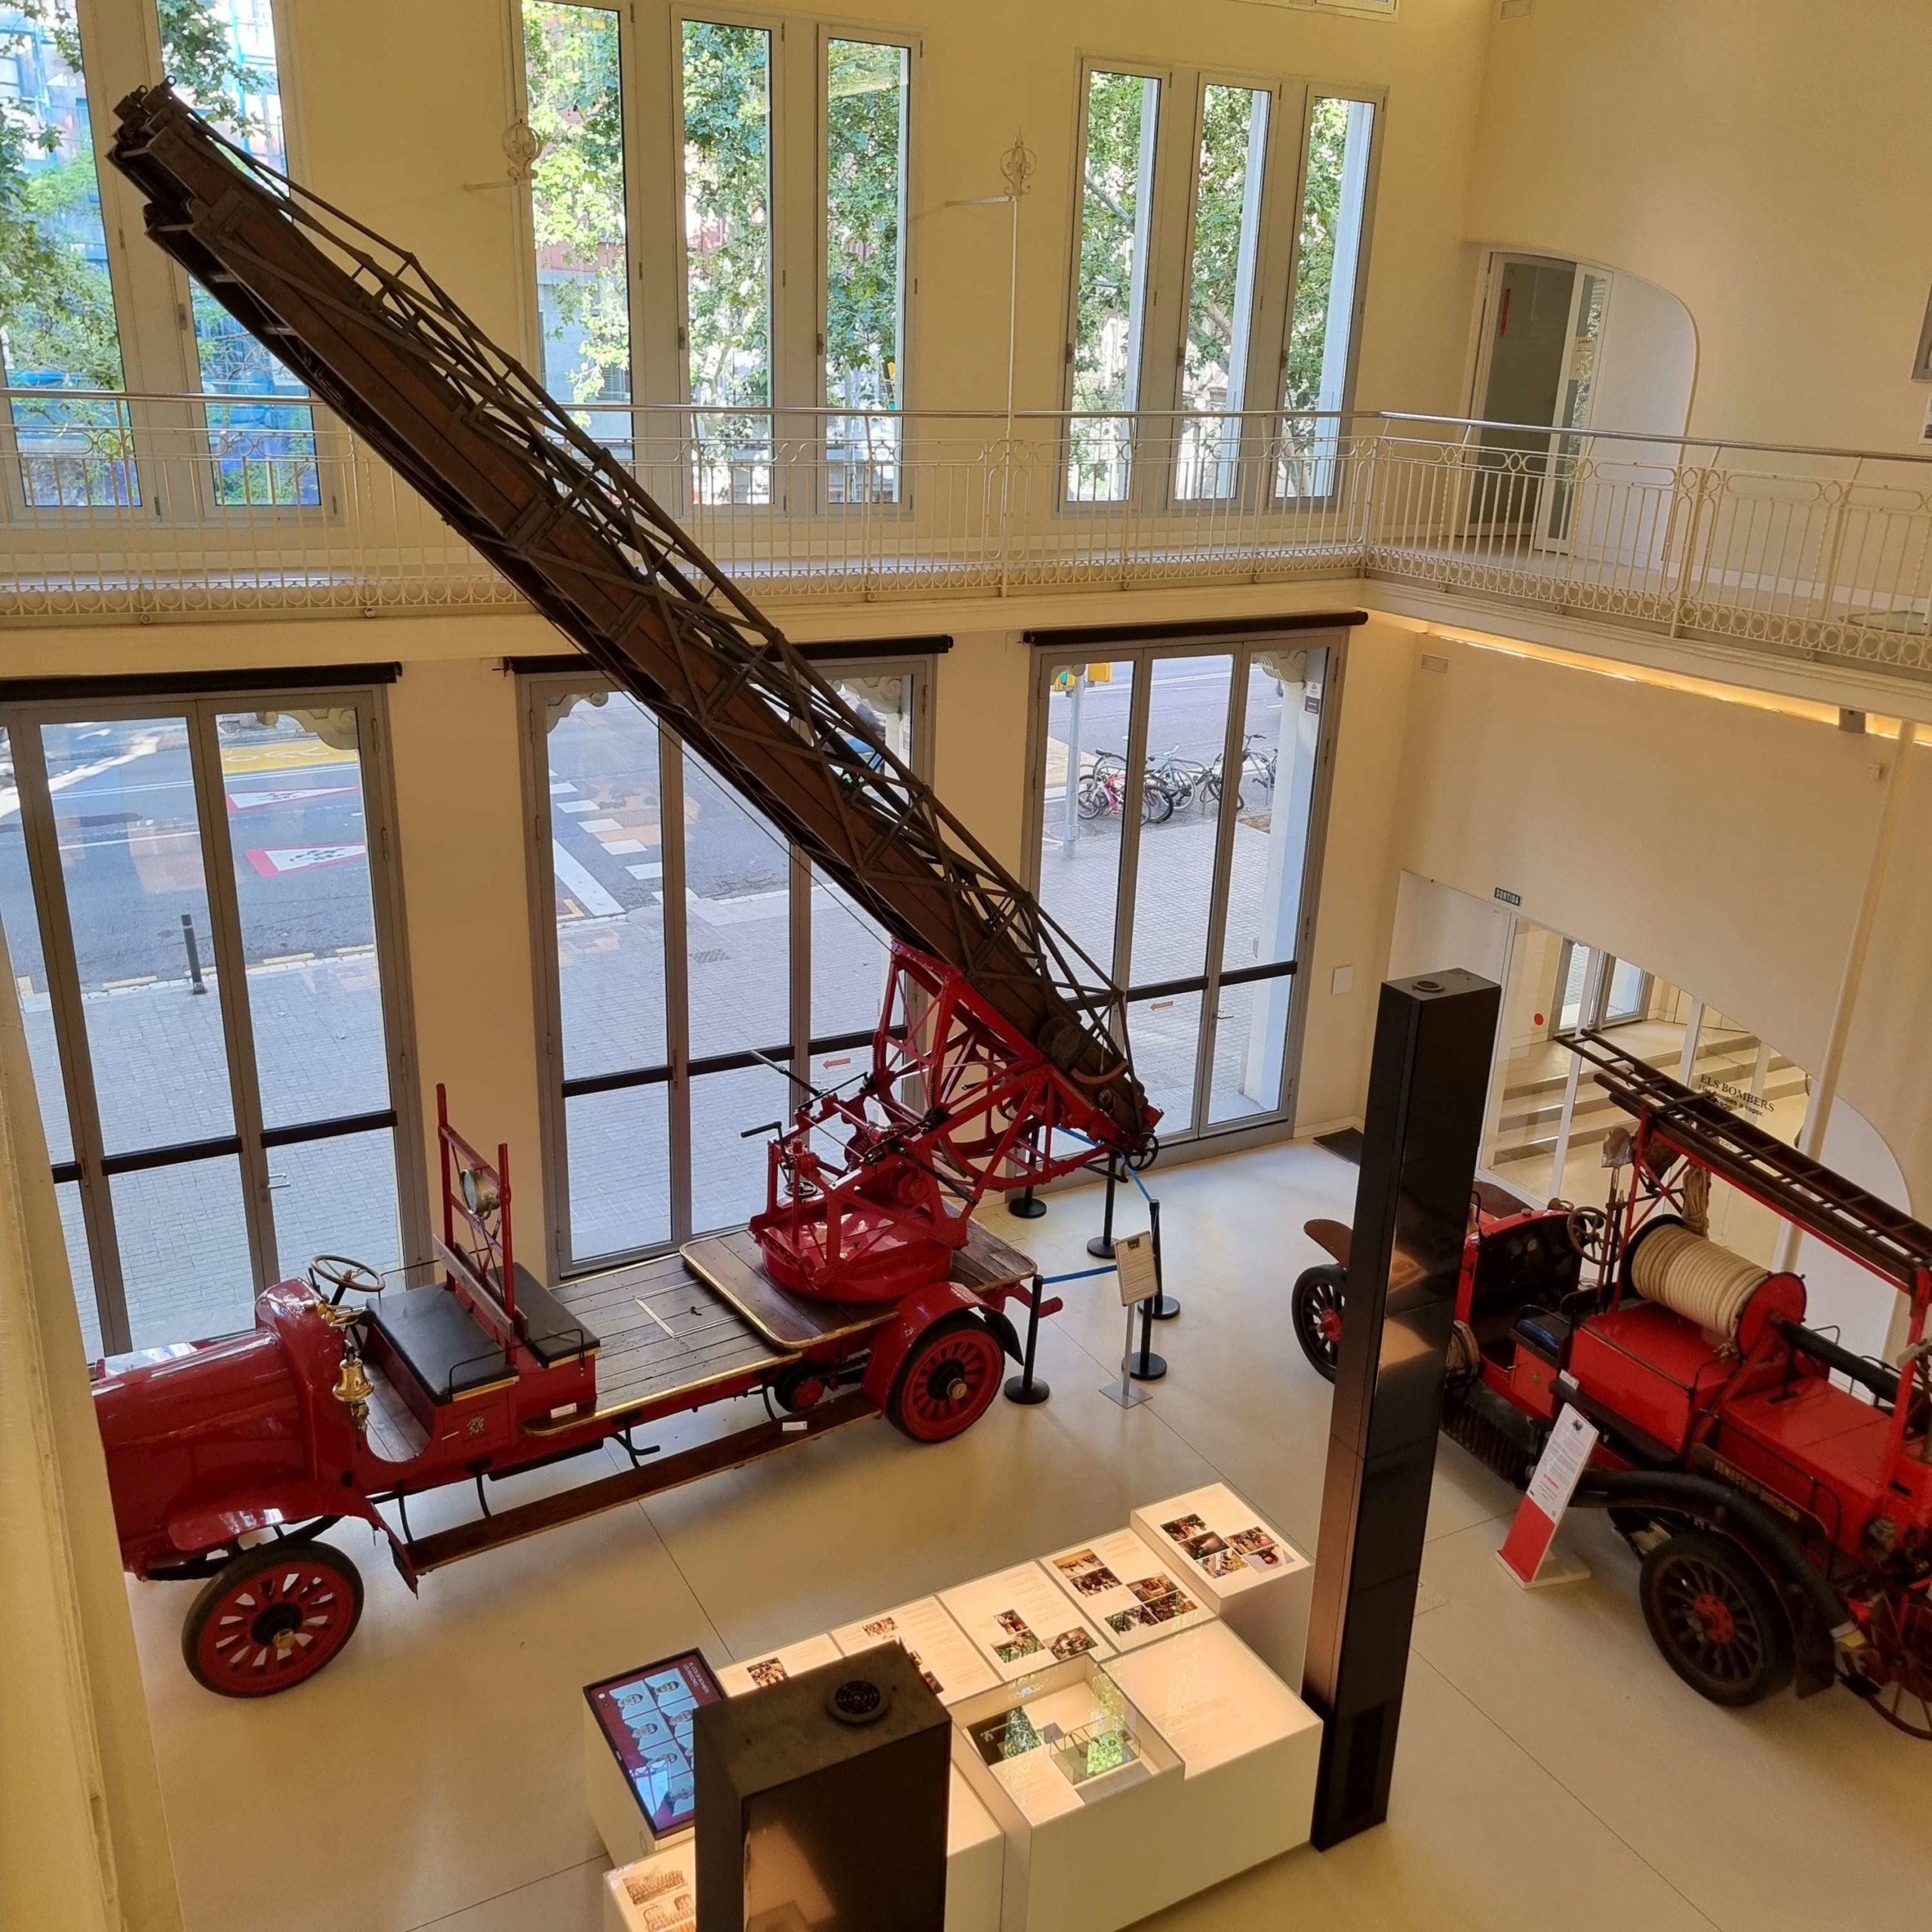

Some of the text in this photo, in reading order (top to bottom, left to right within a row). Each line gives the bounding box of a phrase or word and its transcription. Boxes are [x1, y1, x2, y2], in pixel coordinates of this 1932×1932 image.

[1495, 889, 1519, 904] SORTIDA
[1700, 1074, 1775, 1112] ELS BOMBERS
